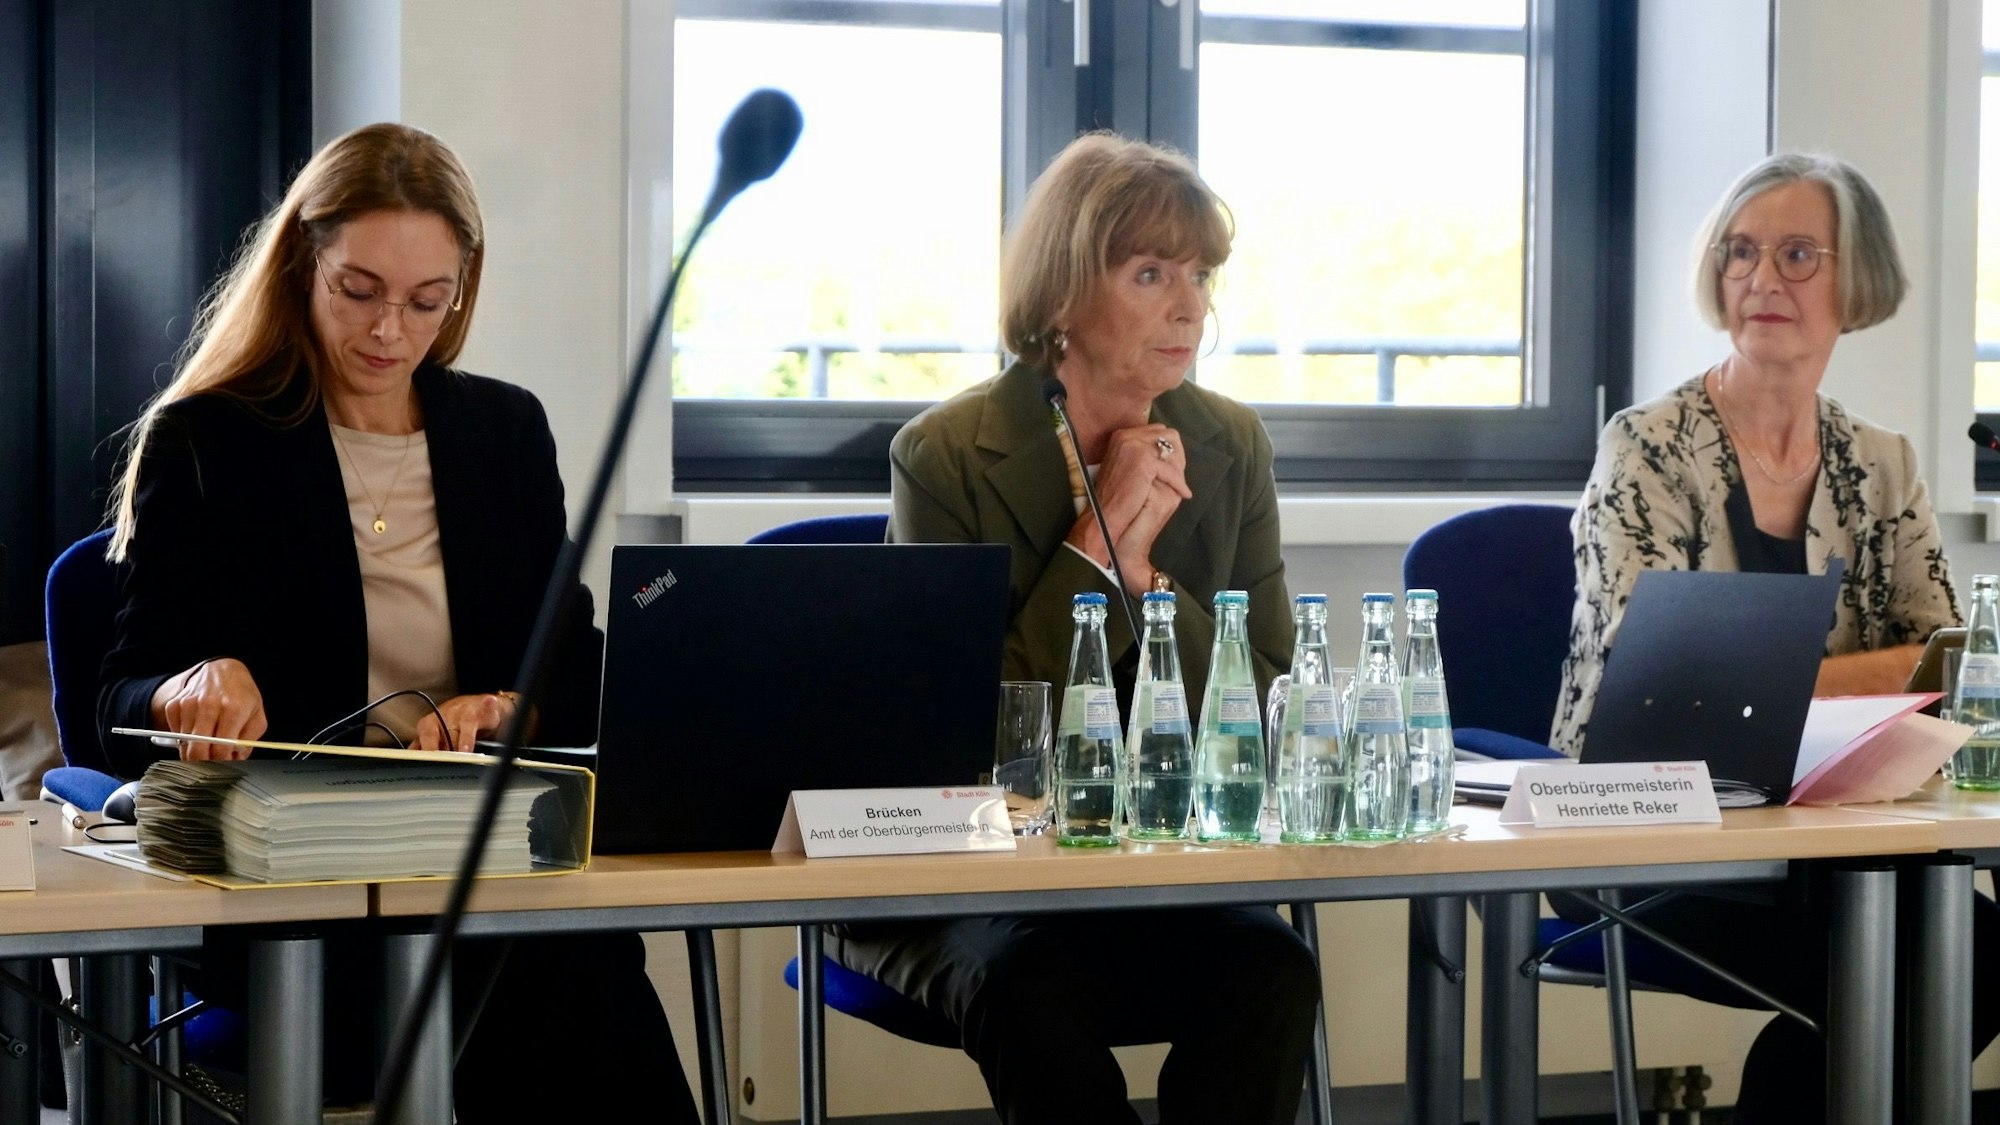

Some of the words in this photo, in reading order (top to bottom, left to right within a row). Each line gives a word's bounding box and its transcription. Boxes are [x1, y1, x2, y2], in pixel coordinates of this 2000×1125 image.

[632, 569, 677, 609] ThinkPad
[1530, 778, 1693, 797] Oberbürgermeisterin
[865, 806, 922, 819] Brücken
[1557, 801, 1630, 817] Henriette
[1634, 800, 1679, 815] Reker
[810, 826, 835, 840] Amt
[838, 825, 859, 839] der
